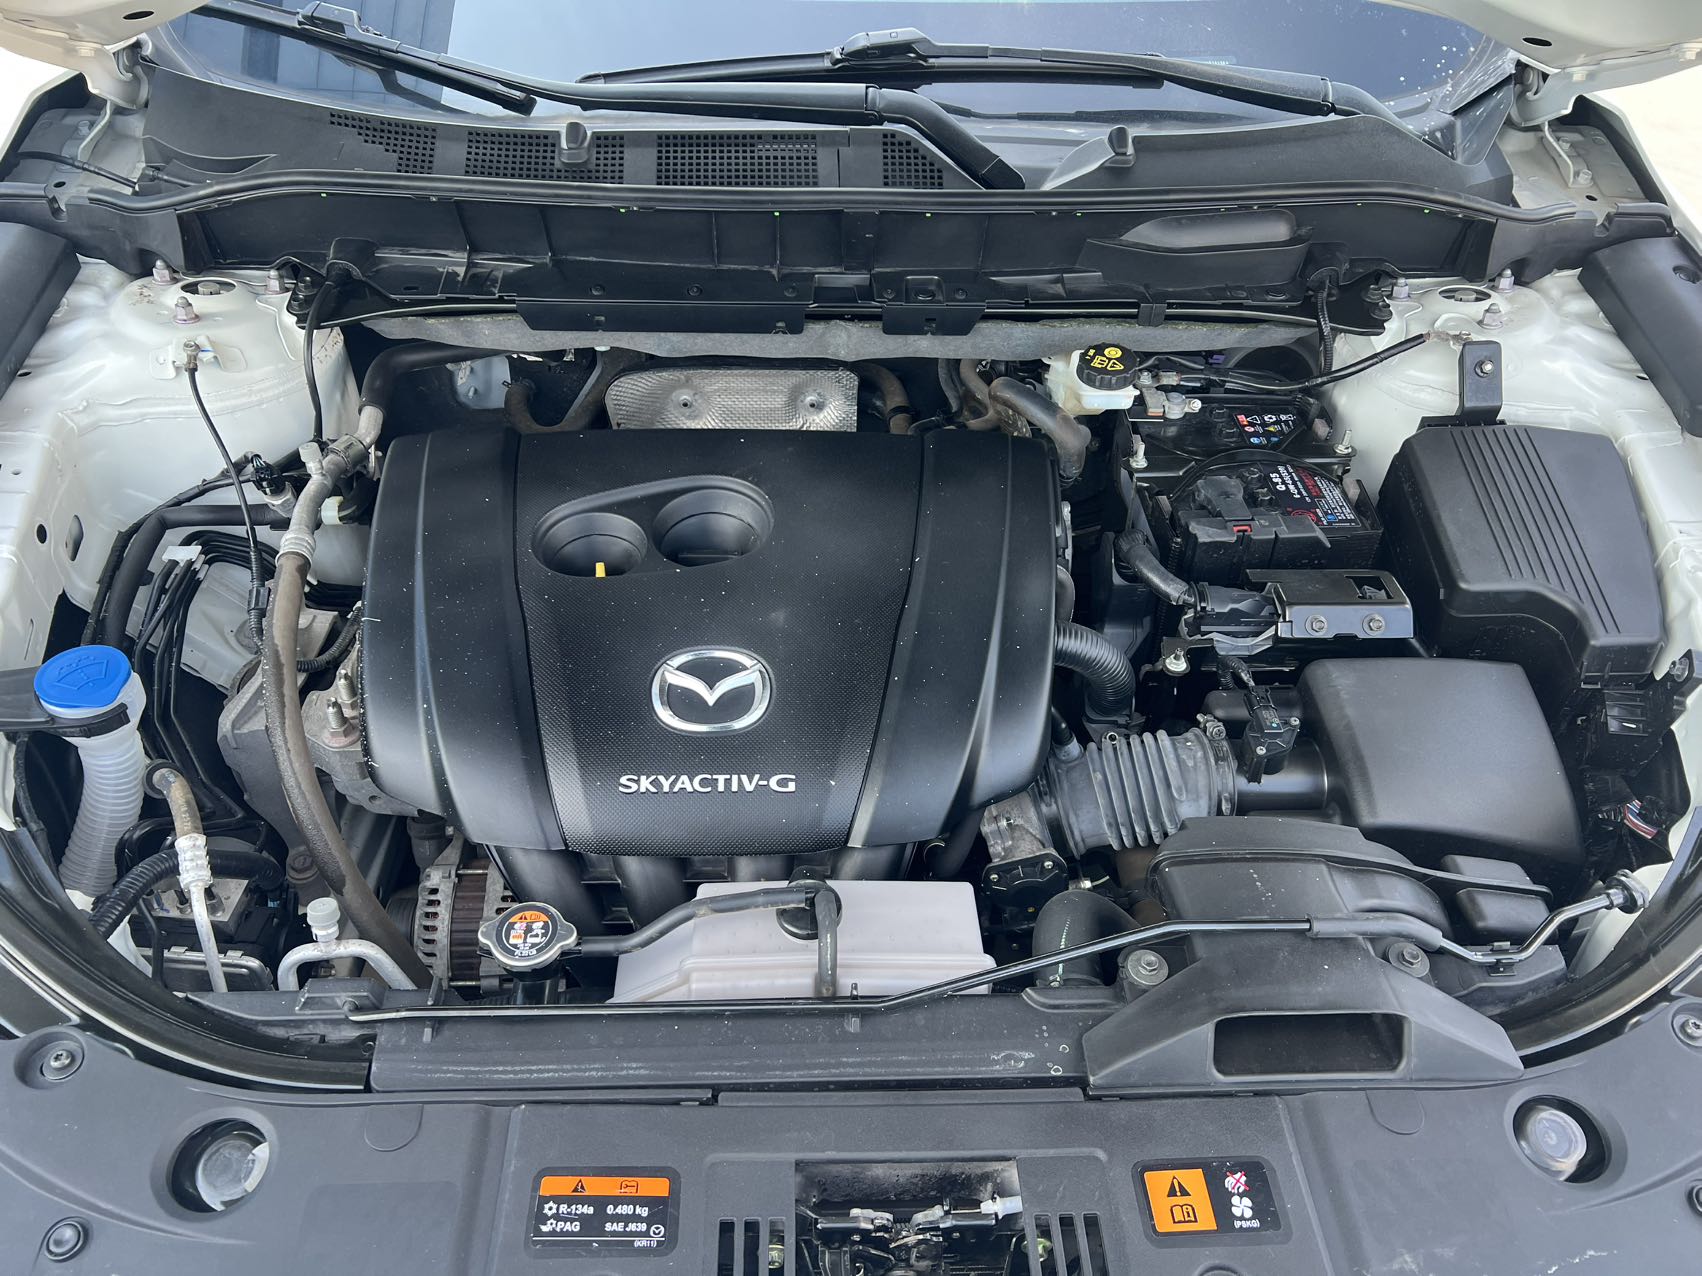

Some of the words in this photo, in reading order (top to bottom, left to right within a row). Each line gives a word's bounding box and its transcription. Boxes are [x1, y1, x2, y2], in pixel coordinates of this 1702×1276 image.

[618, 774, 796, 793] SKYACTIV-G
[558, 1204, 594, 1215] R-134a
[606, 1204, 634, 1214] 0.480
[635, 1204, 649, 1217] kg
[557, 1221, 580, 1232] PAG
[604, 1222, 625, 1232] SAE
[625, 1222, 647, 1232] J639
